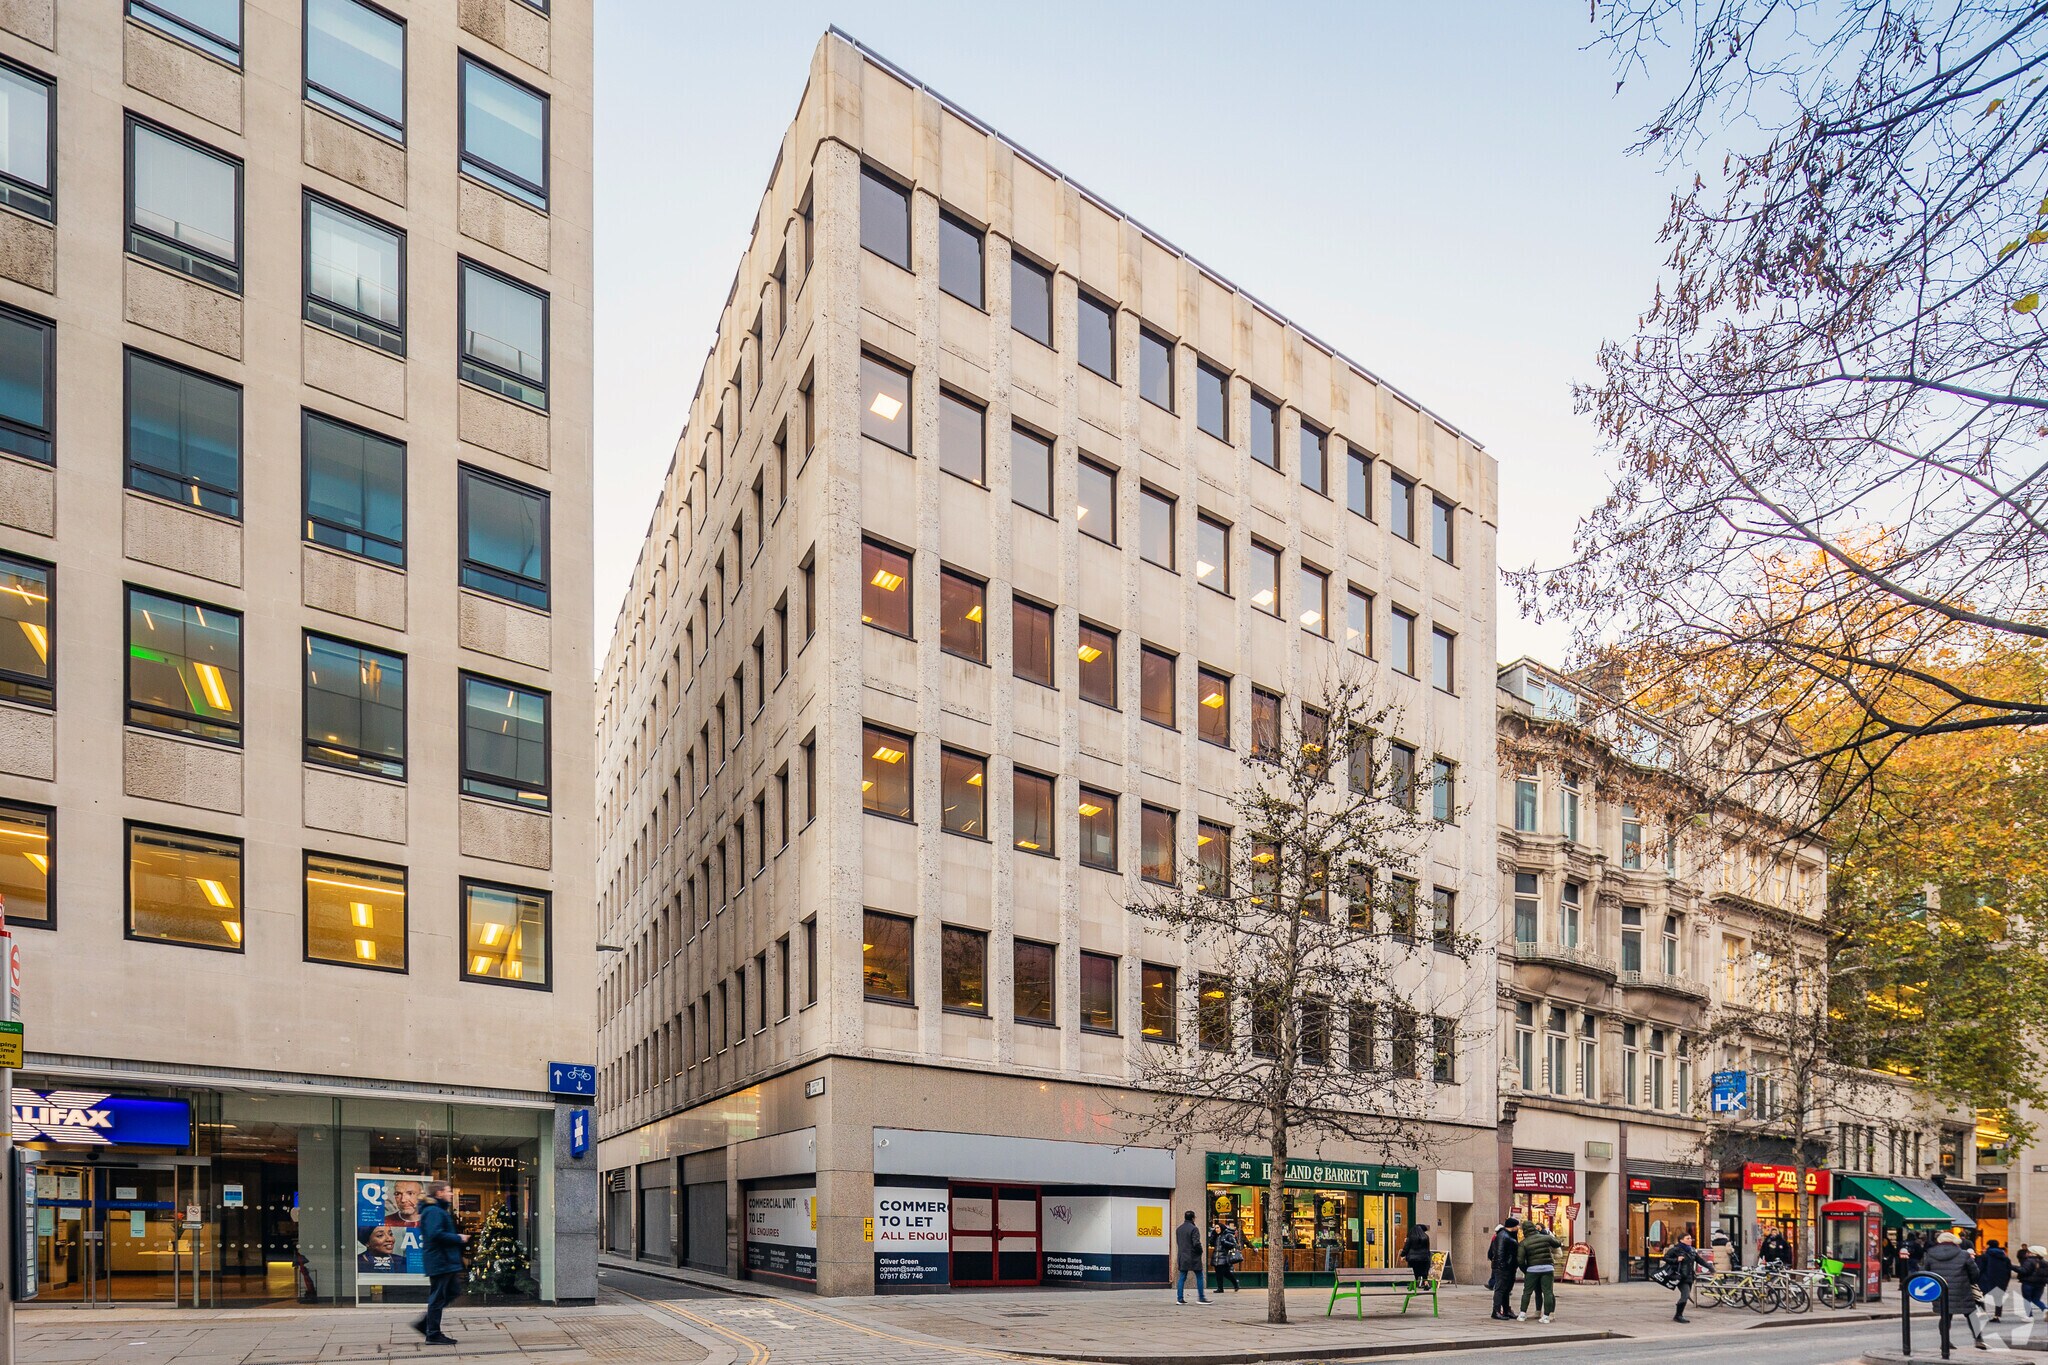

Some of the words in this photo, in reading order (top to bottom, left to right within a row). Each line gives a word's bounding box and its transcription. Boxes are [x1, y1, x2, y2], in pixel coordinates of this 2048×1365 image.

[1716, 1092, 1746, 1111] HK
[1262, 1163, 1311, 1180] HLAND
[1313, 1165, 1324, 1183] &
[1325, 1167, 1369, 1186] BARRETT
[362, 1183, 388, 1206] Q:
[749, 1198, 781, 1208] COMMERCIAL
[783, 1198, 796, 1208] UNIT
[880, 1200, 948, 1212] COMMER
[749, 1213, 755, 1222] TO
[756, 1213, 765, 1223] LET
[880, 1216, 900, 1226] TO
[906, 1217, 933, 1227] LET
[865, 1219, 872, 1228] H
[757, 1228, 779, 1237] ENQUIRIES
[866, 1231, 873, 1240] H
[1138, 1226, 1162, 1236] savills
[400, 1232, 424, 1249] A:
[881, 1232, 904, 1240] ALL
[908, 1232, 947, 1241] ENQUI
[1047, 1264, 1111, 1272] phoebe.bates@savills.com
